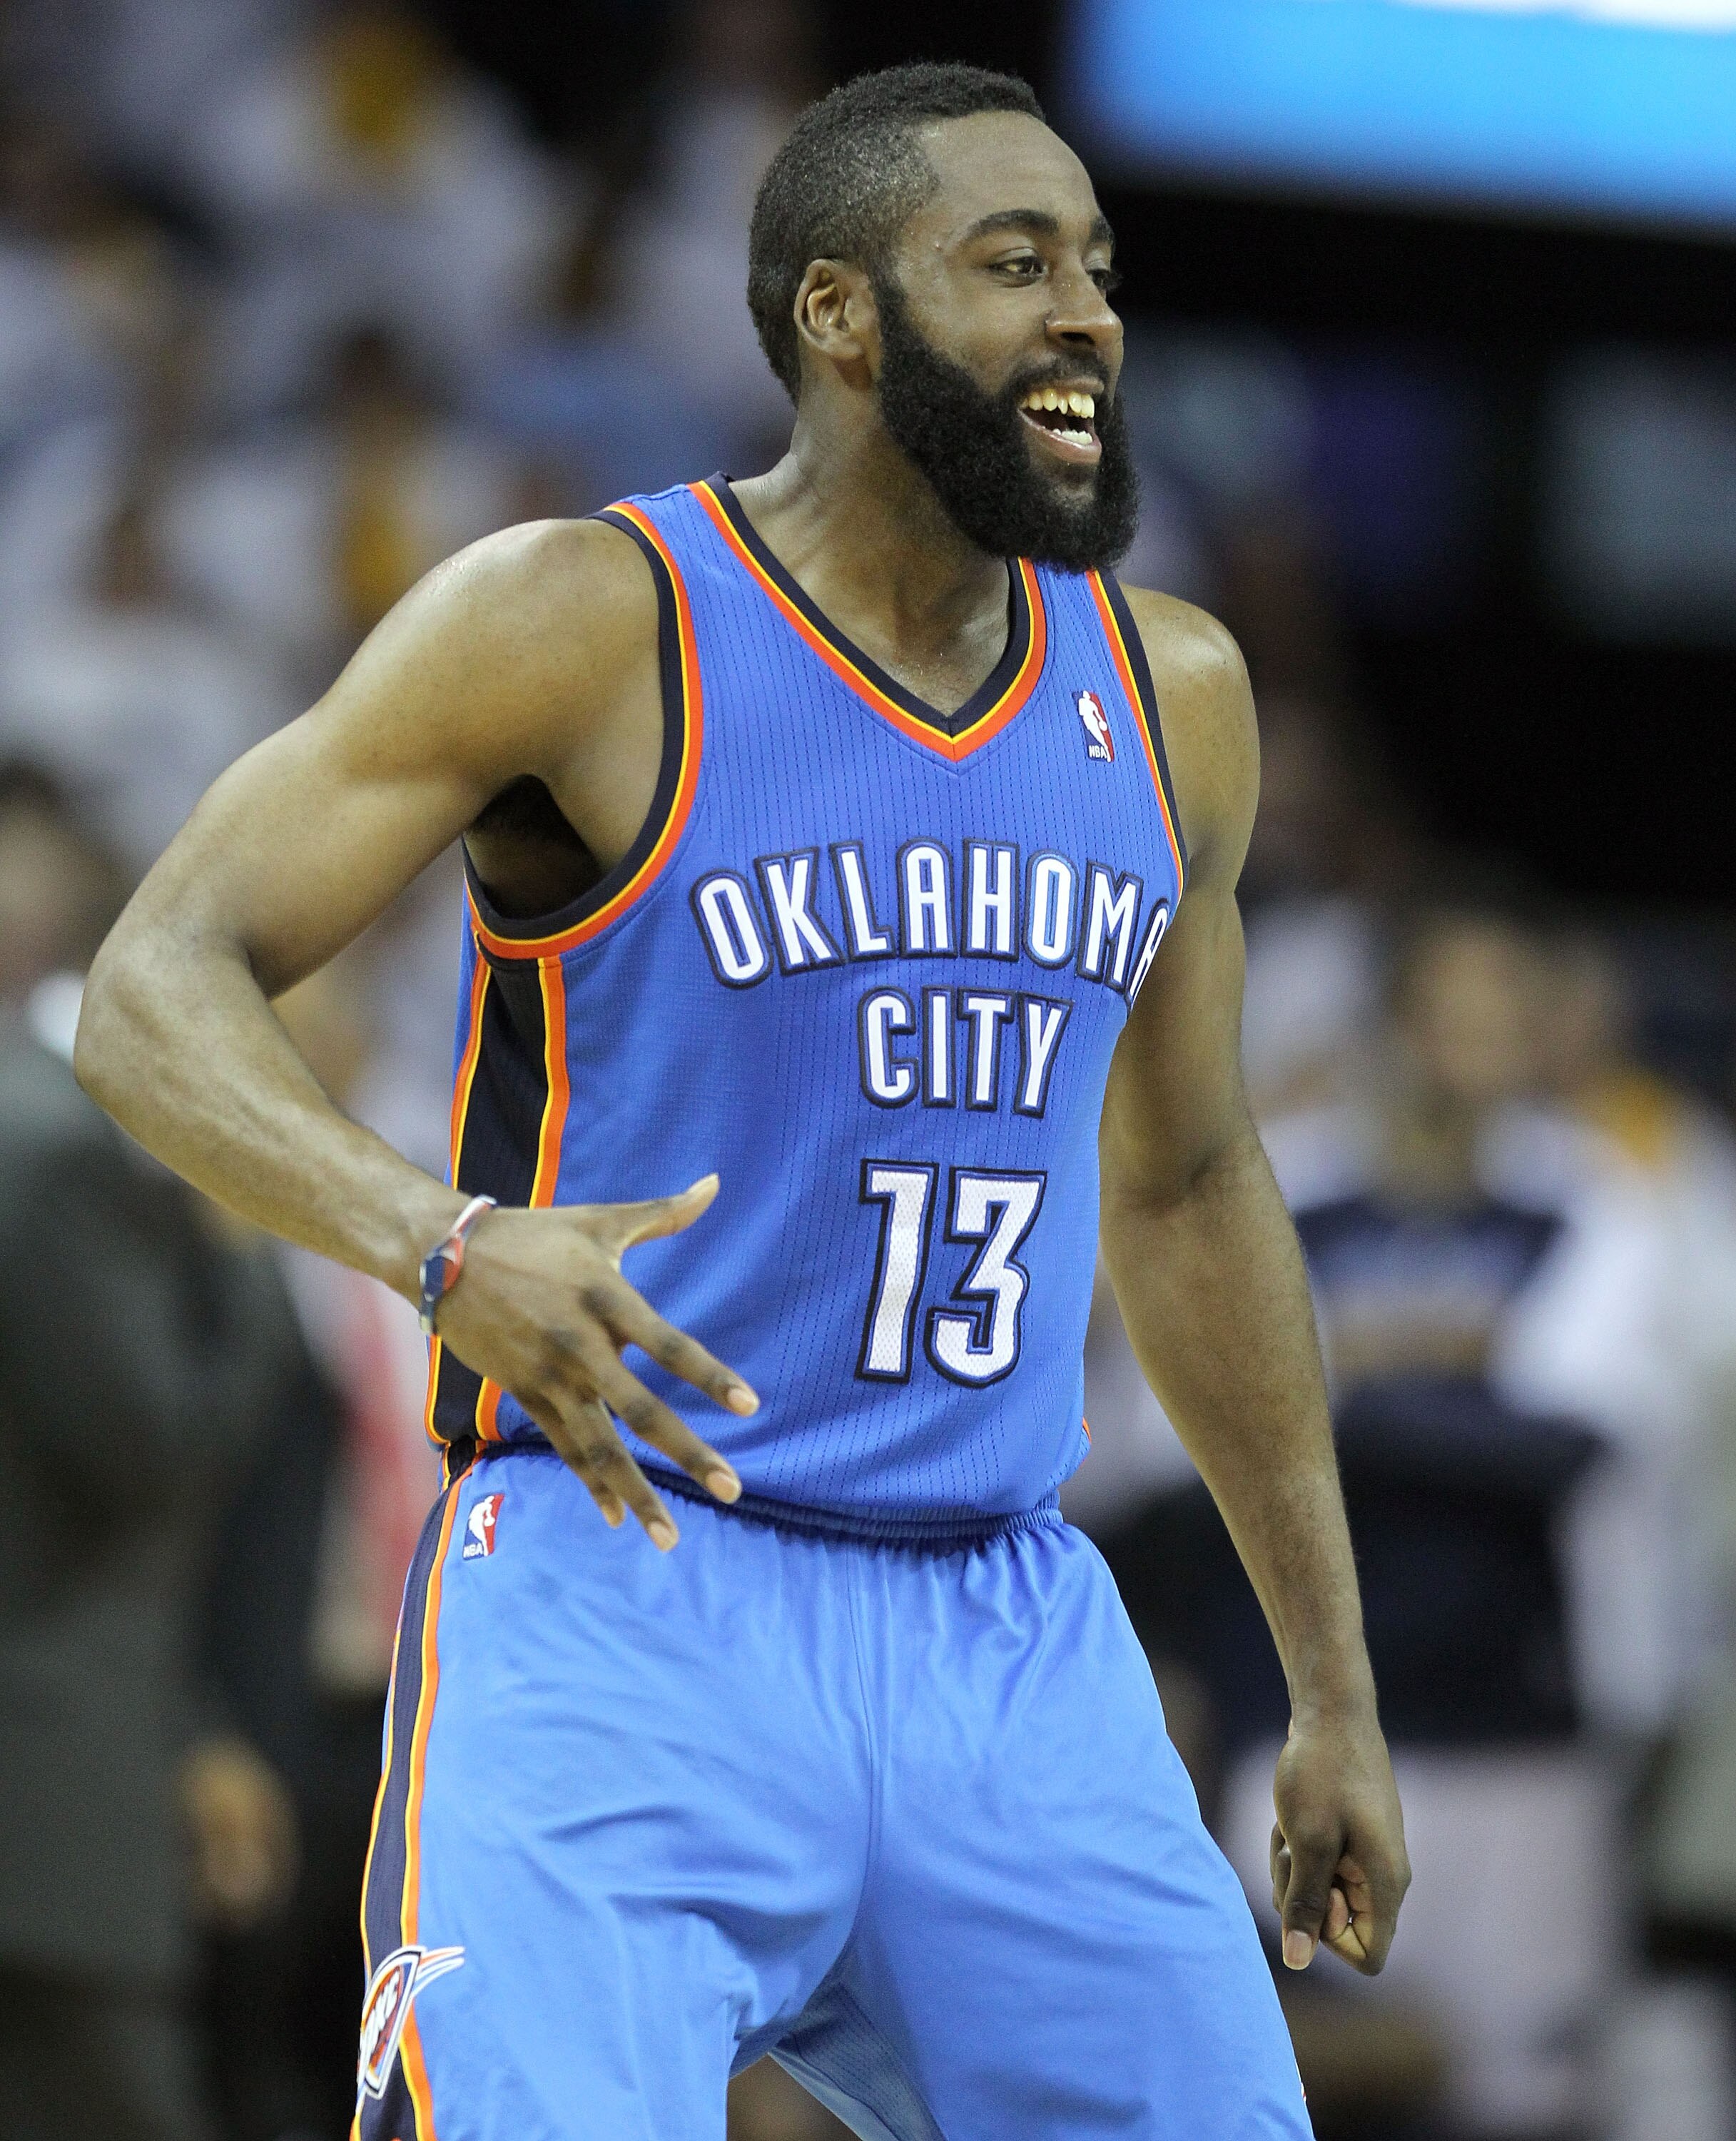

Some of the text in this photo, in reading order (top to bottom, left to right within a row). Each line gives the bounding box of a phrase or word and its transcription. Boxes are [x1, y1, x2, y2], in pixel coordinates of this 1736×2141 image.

[1088, 744, 1107, 759] NBA
[691, 837, 1169, 1013] OKLAHOMA
[858, 986, 1075, 1118] CITY
[855, 1158, 1047, 1389] 13
[462, 1542, 484, 1559] NBA
